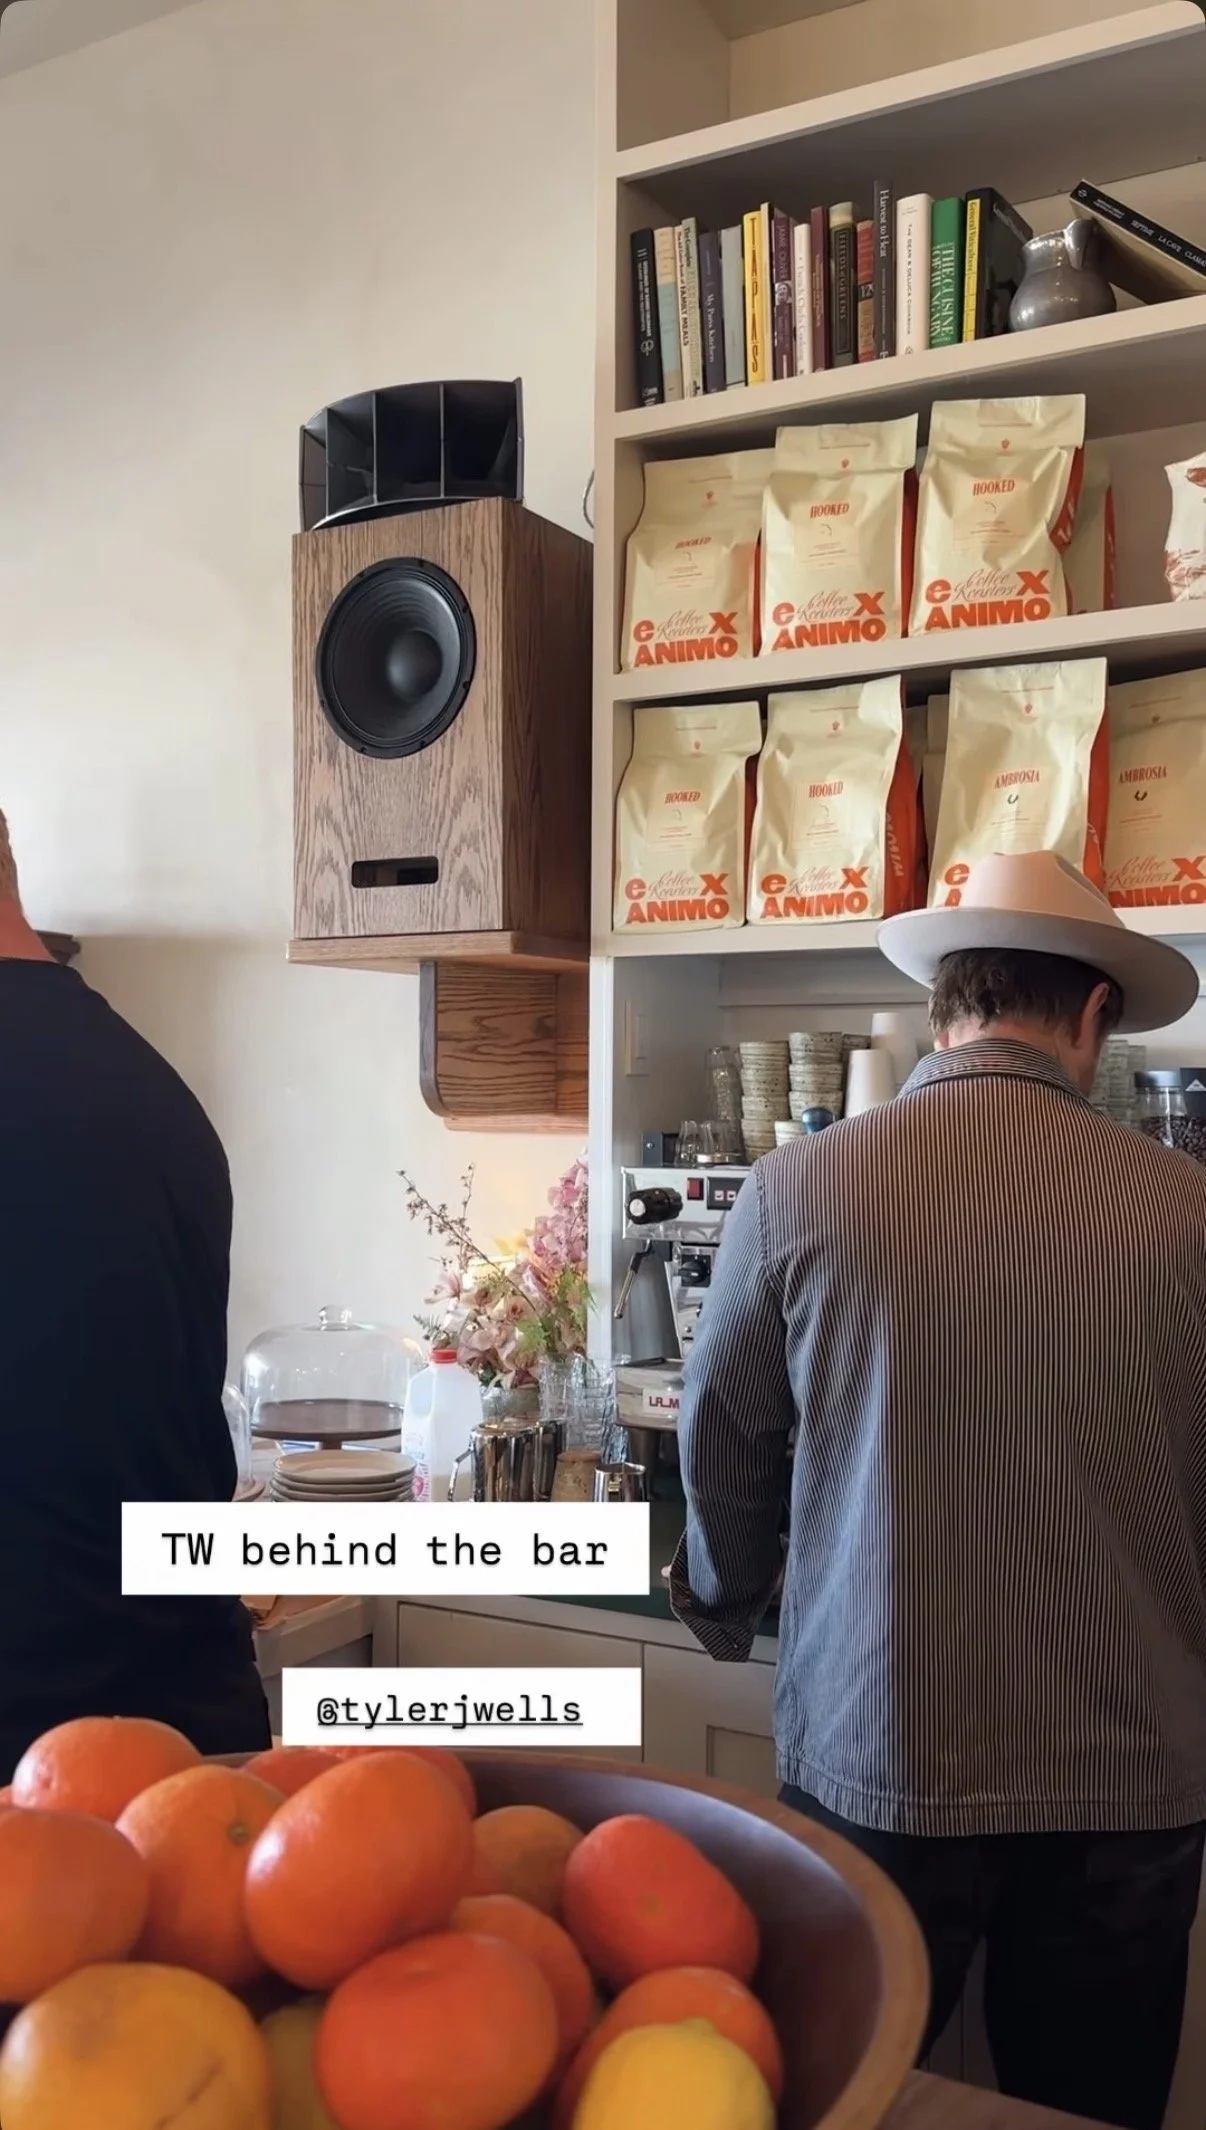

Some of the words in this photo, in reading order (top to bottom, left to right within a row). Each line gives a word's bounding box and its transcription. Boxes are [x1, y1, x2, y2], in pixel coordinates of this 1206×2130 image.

[879, 189, 889, 225] Harvest
[880, 226, 888, 235] to
[880, 236, 889, 258] Heat
[941, 278, 954, 336] CUISINE
[973, 479, 1015, 496] HOOKED
[810, 502, 850, 519] HOOKED
[924, 597, 1051, 631] ANIMO
[772, 618, 886, 651] ANIMO
[634, 636, 738, 668] ANIMO
[994, 769, 1040, 789] AMBROSIA
[1118, 765, 1167, 785] AMBROSIA
[665, 791, 701, 804] HOOKED
[809, 780, 844, 799] HOOKED
[760, 890, 869, 919] ANIMO
[1108, 883, 1206, 908] NIMO
[626, 898, 729, 925] ANIMO
